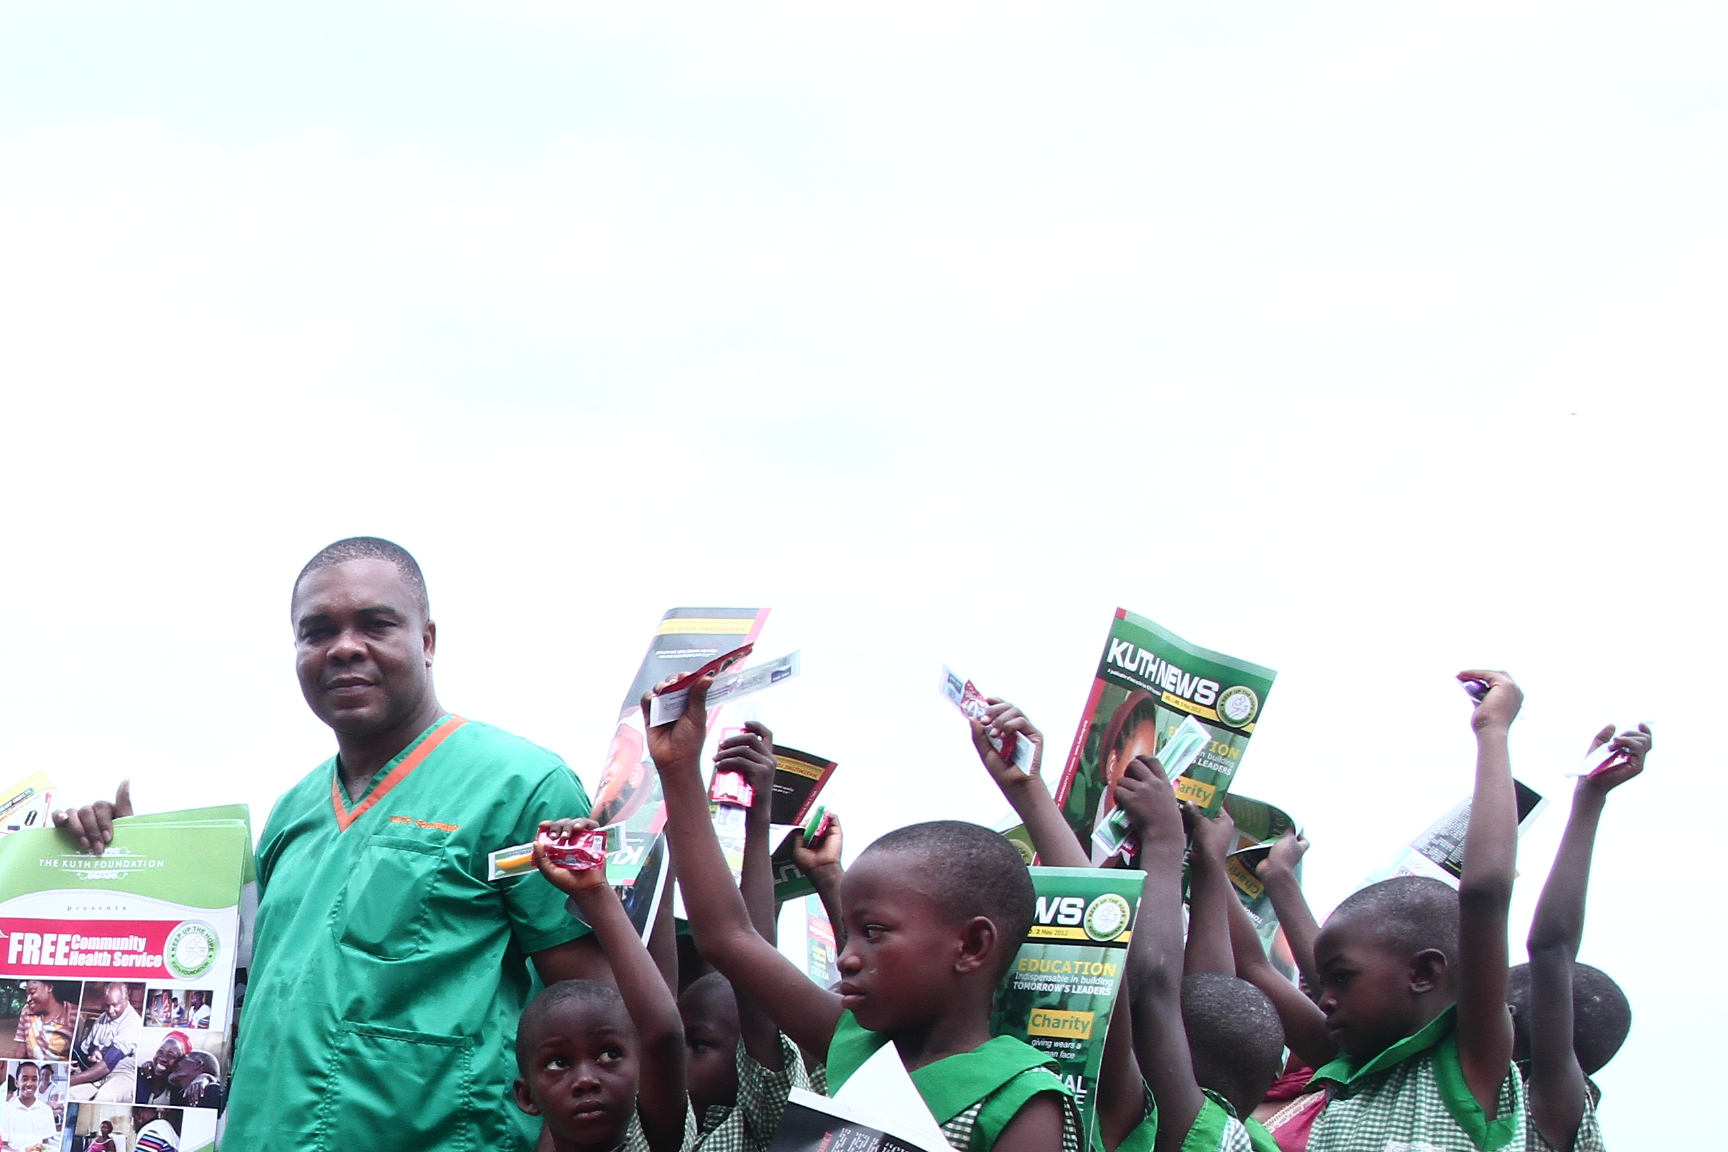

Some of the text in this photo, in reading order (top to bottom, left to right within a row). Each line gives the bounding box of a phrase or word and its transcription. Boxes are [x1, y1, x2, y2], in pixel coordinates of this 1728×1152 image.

[1107, 637, 1160, 682] KUTH
[1156, 660, 1219, 706] NEWS
[1197, 758, 1232, 775] LEADERS
[1206, 752, 1235, 768] building
[1179, 784, 1212, 801] arity
[39, 859, 165, 868] THE KUTH FOUNDATION
[72, 935, 146, 952] Community
[171, 933, 181, 951] KEEP
[193, 926, 205, 934] THE
[8, 932, 72, 966] FREE
[69, 952, 162, 968] Health Service
[1018, 957, 1117, 977] EDUCATION
[1015, 973, 1068, 983] Indispensable
[1080, 976, 1113, 986] building
[1014, 981, 1111, 996] TOMORROW'S LEADERS
[1031, 1013, 1089, 1032] Charity
[1031, 1039, 1052, 1047] giving
[1053, 1041, 1074, 1049] wears
[1059, 1051, 1075, 1059] face
